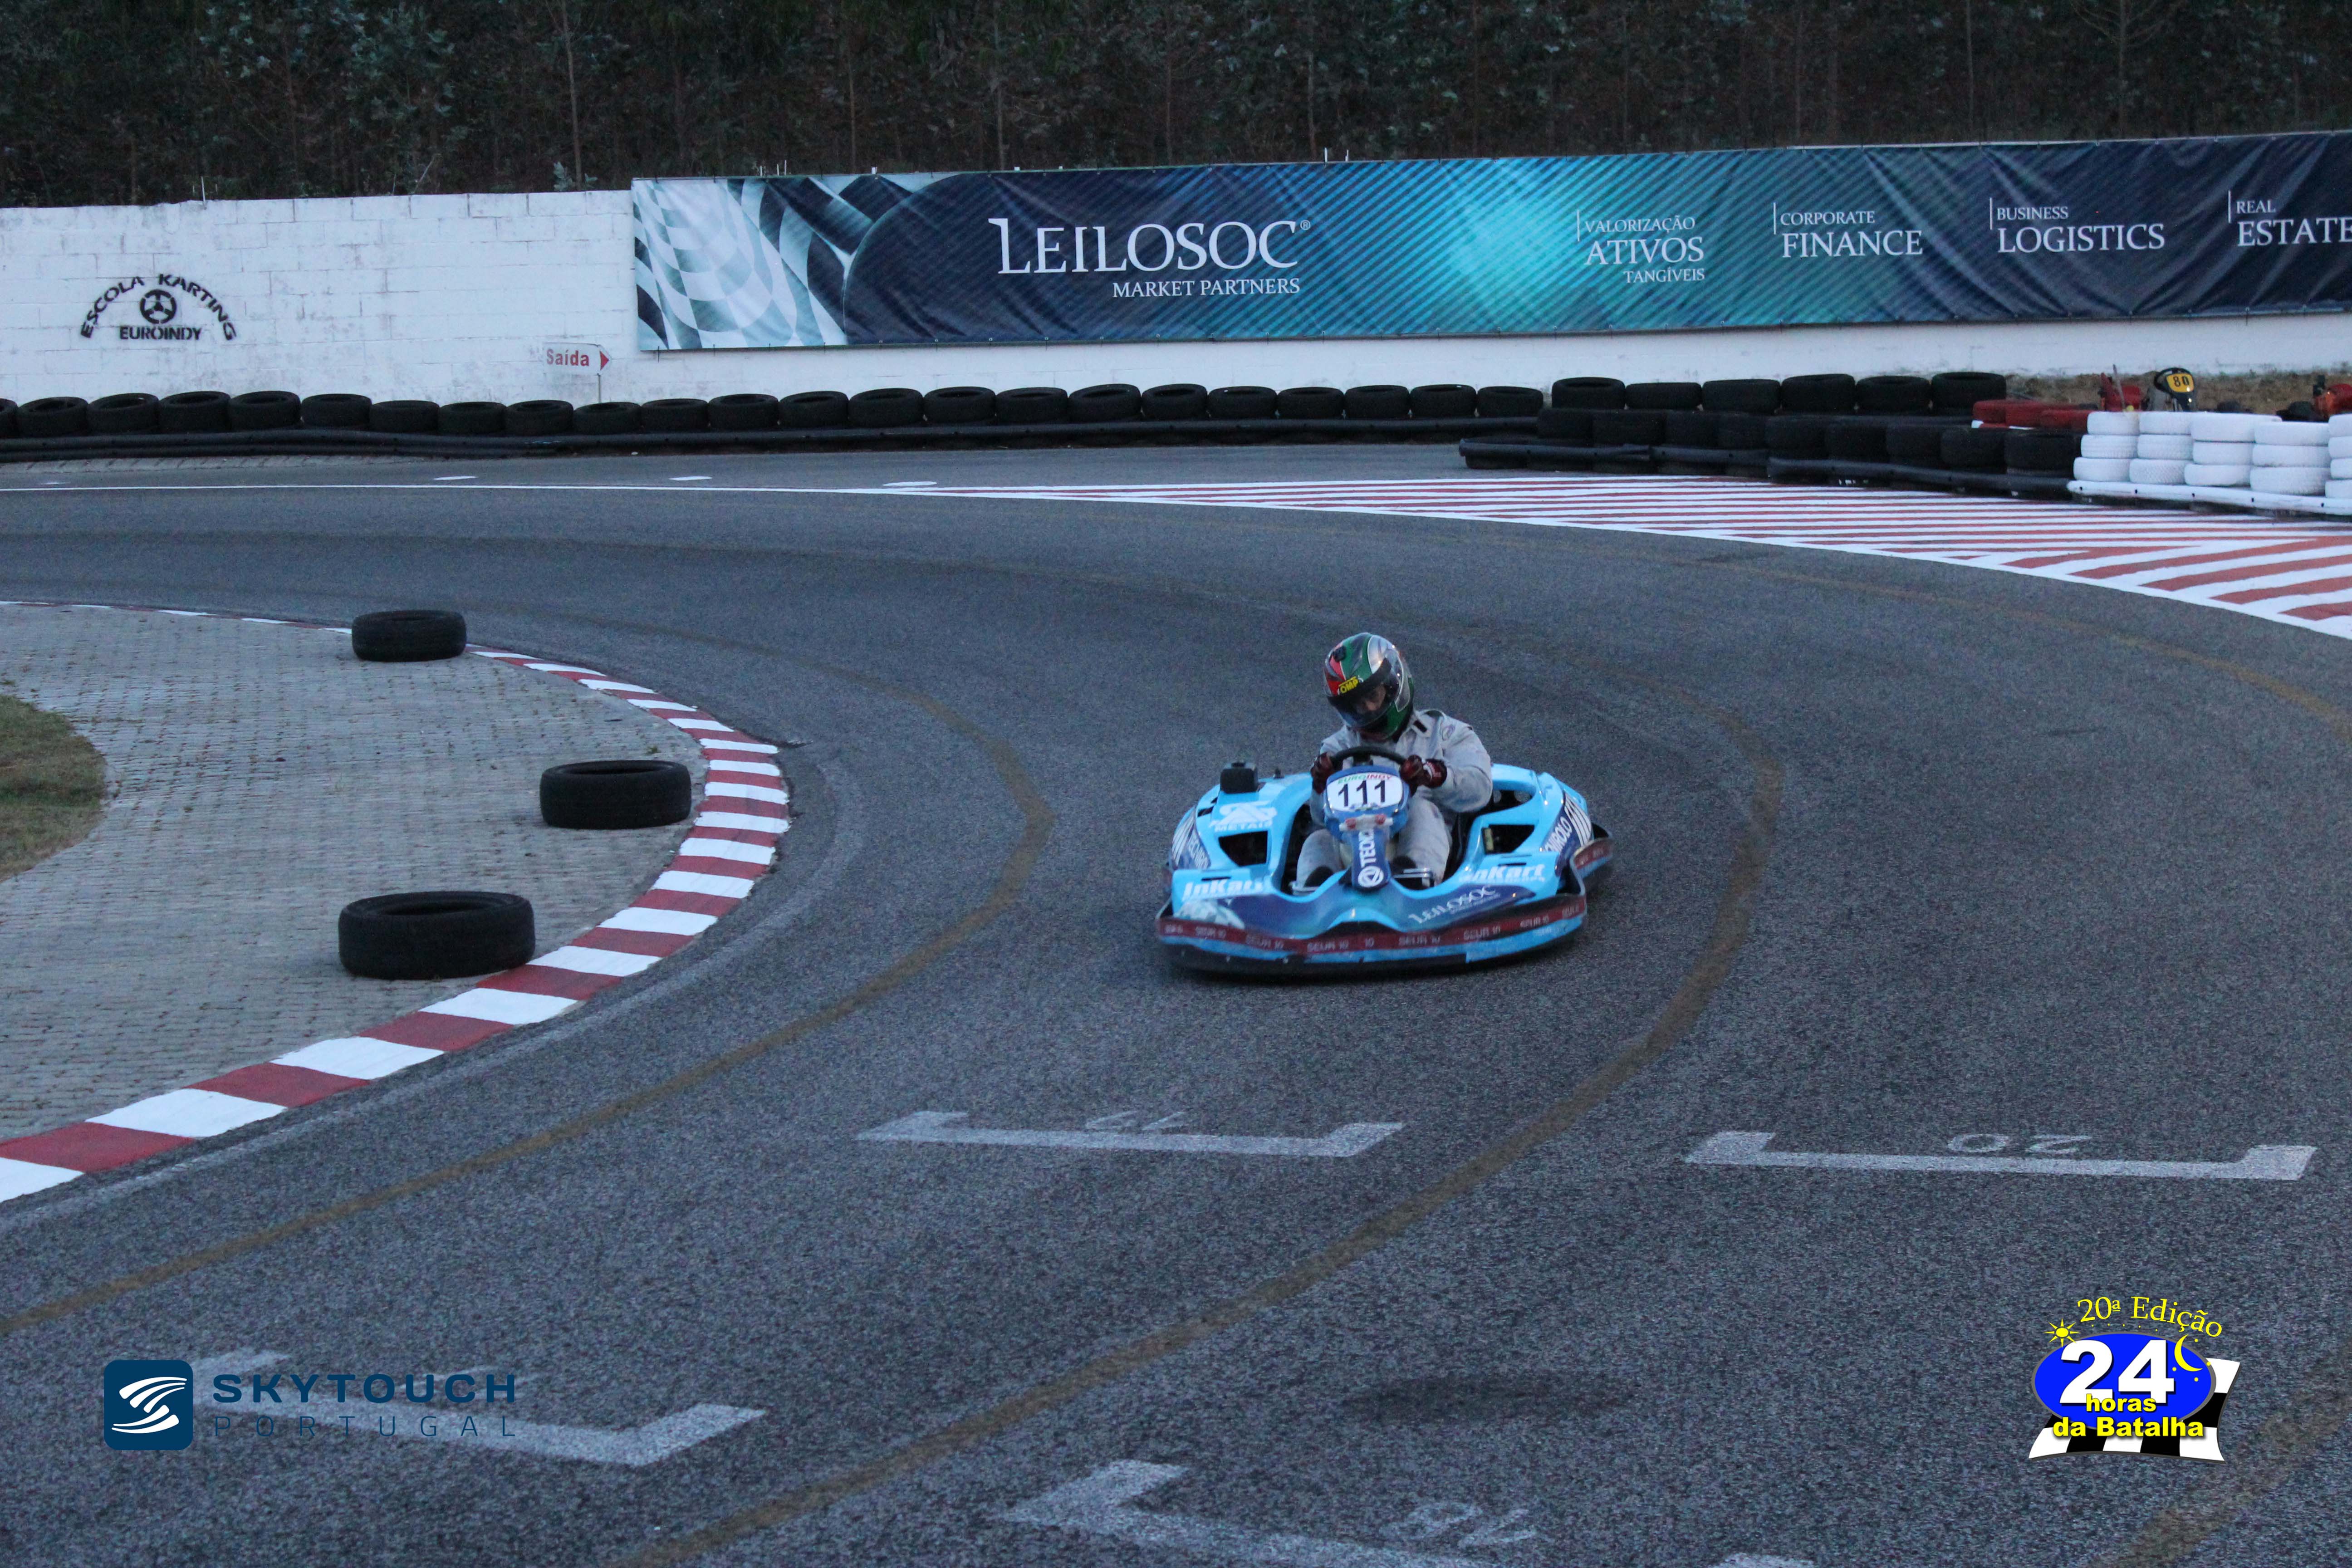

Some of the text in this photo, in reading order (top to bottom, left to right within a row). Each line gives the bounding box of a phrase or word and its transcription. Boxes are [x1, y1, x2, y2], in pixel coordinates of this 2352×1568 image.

[1997, 206, 2068, 220] BUSINESS
[2236, 200, 2275, 214] REAL
[1585, 215, 1695, 233] VALORIZAÇÃO
[1780, 211, 1875, 226] CORPORATE
[1782, 230, 1923, 258] FINANCE
[1998, 223, 2165, 253] LOGISTICS
[1584, 236, 1704, 266] ATIVOS
[1623, 267, 1705, 284] TANGÍVEIS
[1112, 278, 1300, 298] MARKET PARTNERS
[80, 273, 237, 341] ESCOLA KARTING
[119, 325, 202, 341] EUROINDY
[546, 348, 590, 367] Saída
[2173, 375, 2190, 387] 80
[1340, 677, 1359, 694] OMP
[1338, 774, 1392, 784] EUROINDY
[1338, 780, 1385, 807] 111
